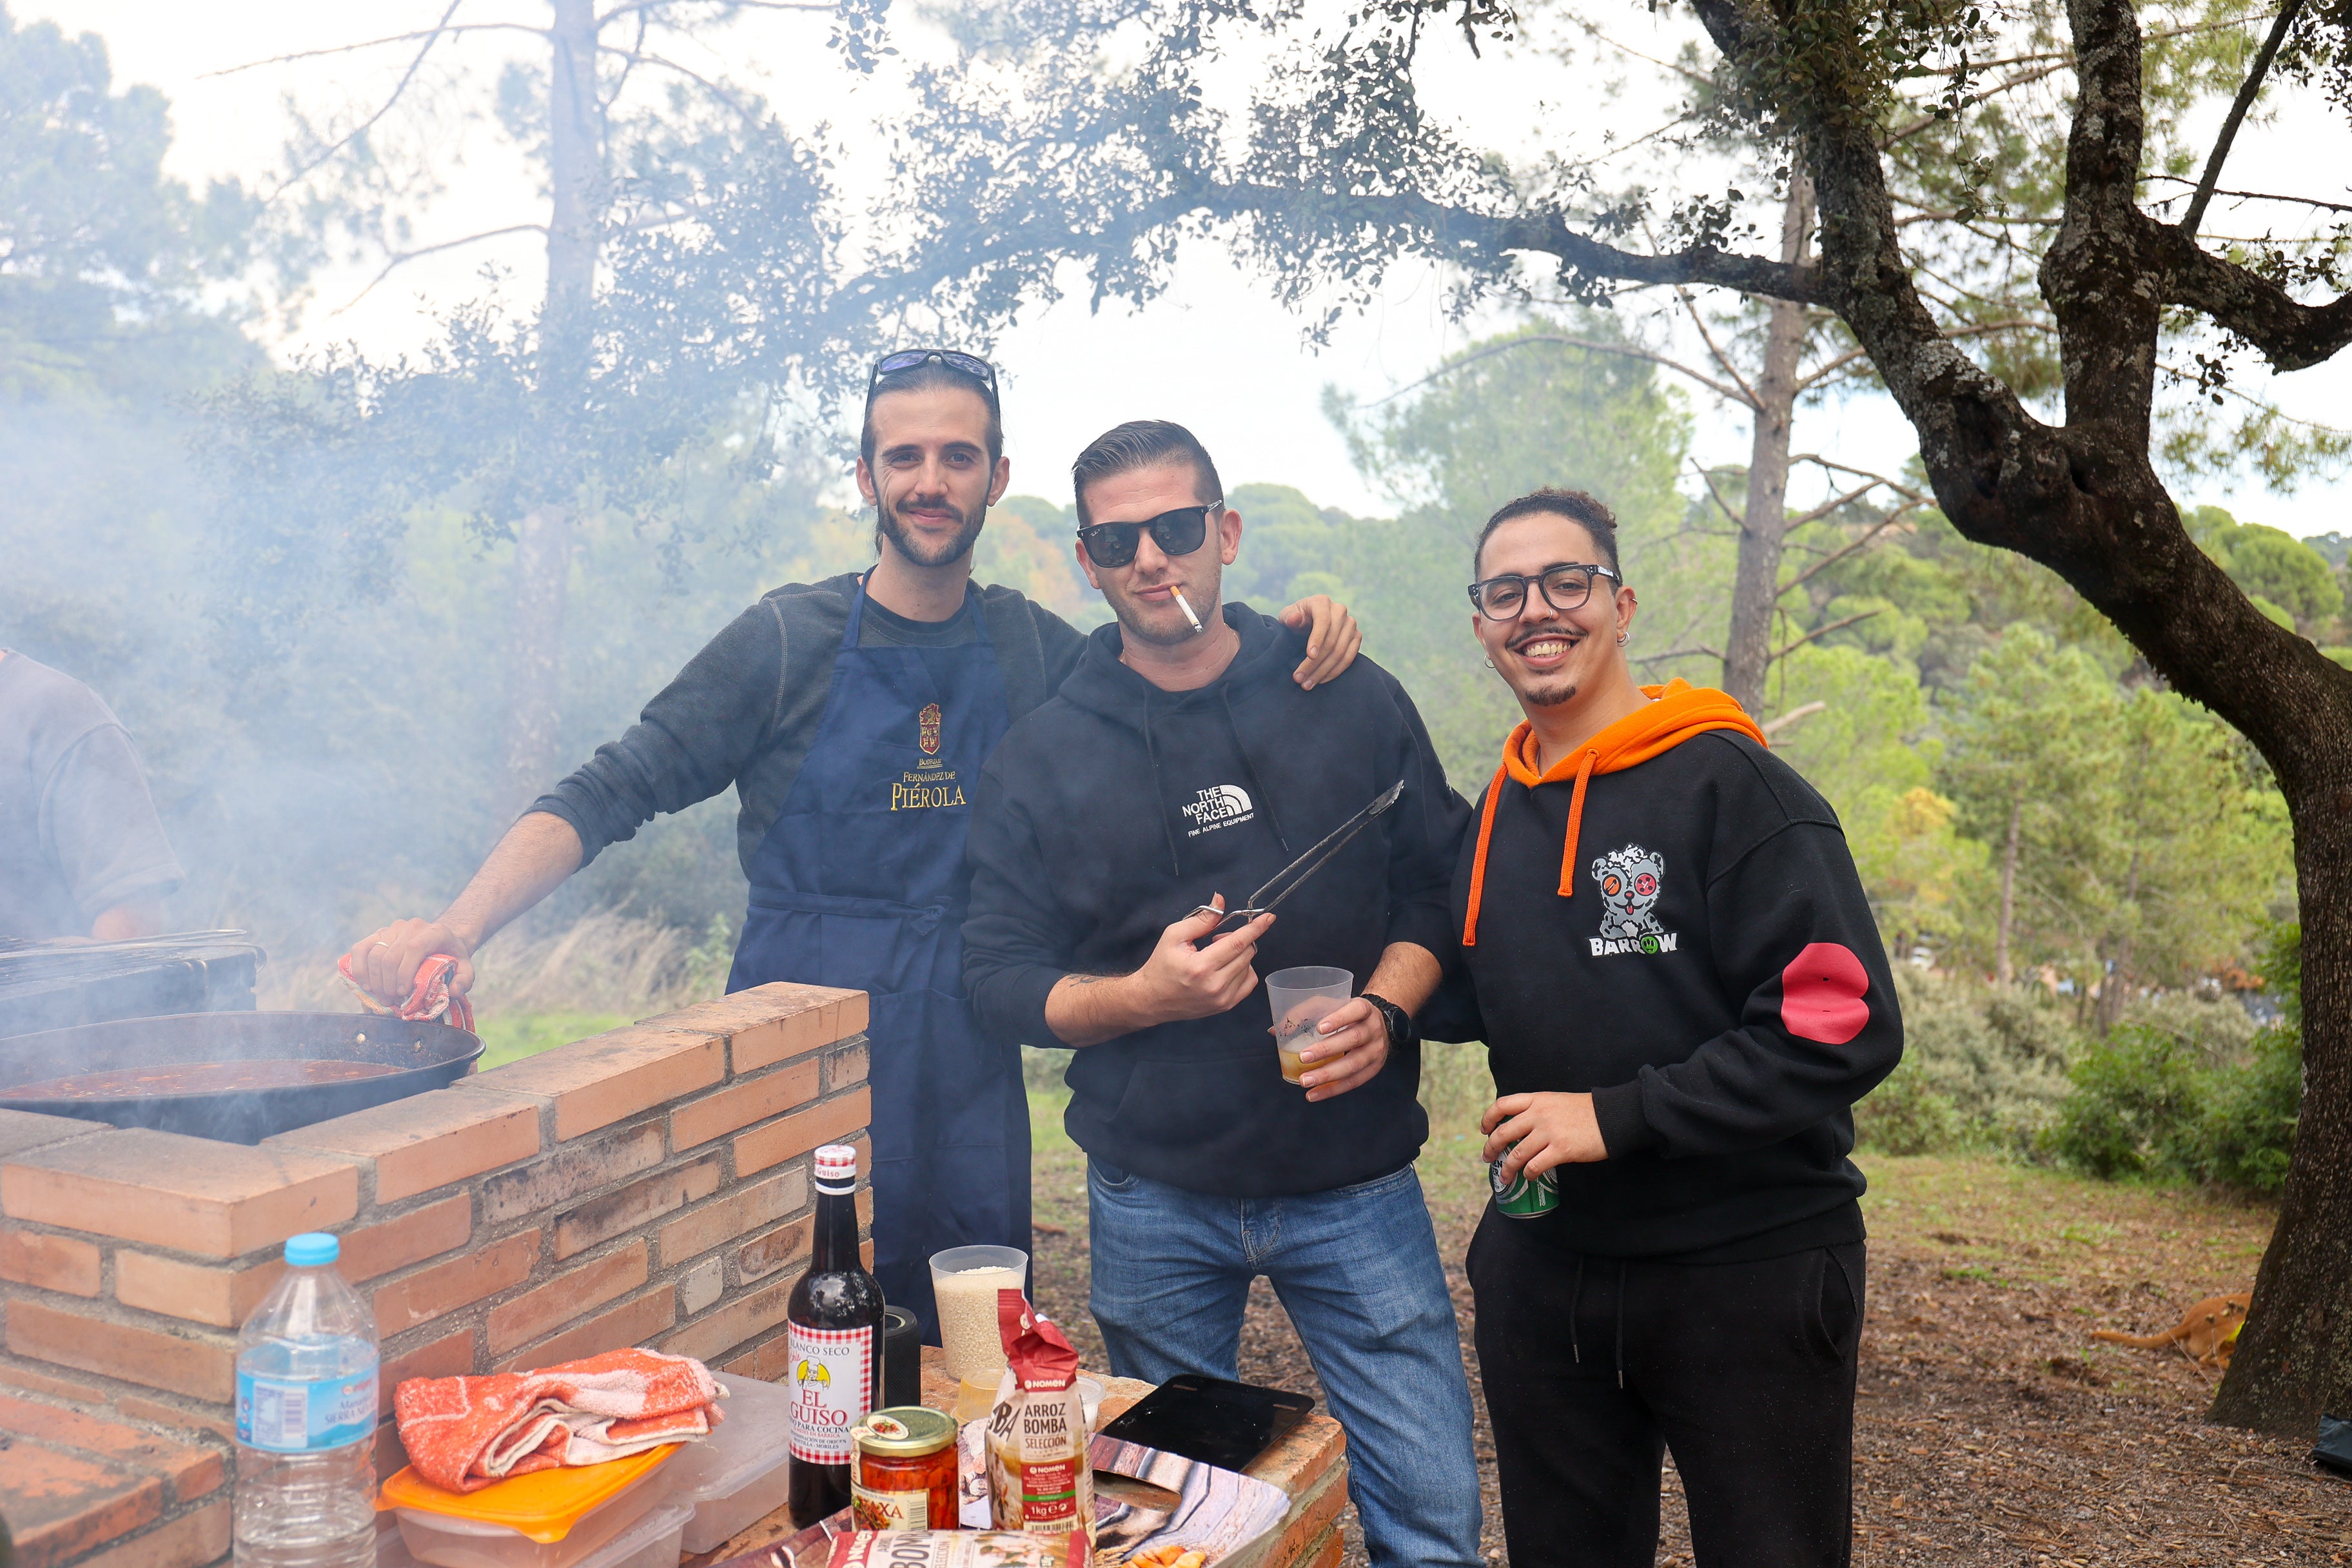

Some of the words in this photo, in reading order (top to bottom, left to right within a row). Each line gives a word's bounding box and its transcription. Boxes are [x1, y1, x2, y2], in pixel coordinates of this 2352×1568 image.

[945, 770, 956, 780] DE
[890, 782, 966, 811] PIÉROLA
[1196, 786, 1222, 801] THE
[1182, 796, 1224, 817] NORTH
[1195, 807, 1228, 825] FACE
[1188, 828, 1201, 838] FINE
[1202, 822, 1222, 833] ALPINE
[1222, 812, 1254, 827] EQUIPMENT
[817, 1167, 839, 1178] Guiso
[823, 1347, 850, 1356] SECO
[802, 1389, 827, 1409] EL
[790, 1401, 848, 1427] GUISO
[1024, 1403, 1066, 1417] ARROZ
[798, 1422, 815, 1432] PARA
[1024, 1417, 1067, 1435] BOMBA
[1025, 1434, 1067, 1449] SELECCIÓN
